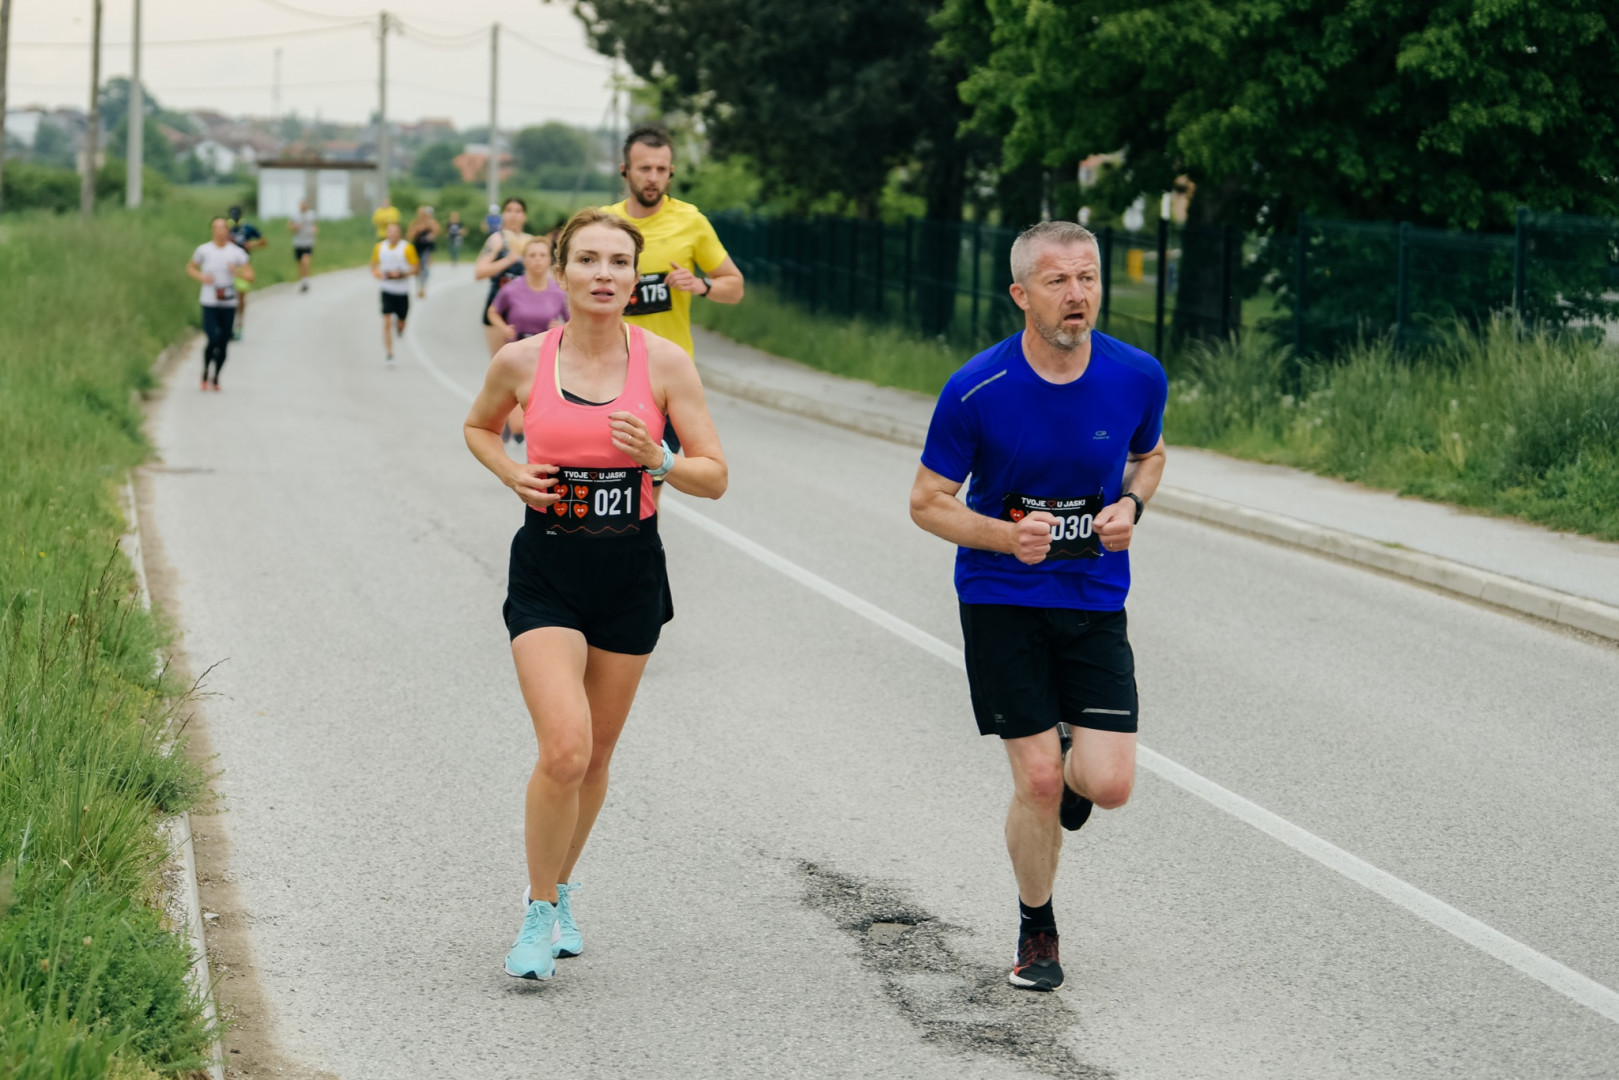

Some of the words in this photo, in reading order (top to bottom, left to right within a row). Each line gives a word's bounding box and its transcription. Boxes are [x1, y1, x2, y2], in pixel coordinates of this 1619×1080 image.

[640, 283, 668, 303] 175
[563, 470, 589, 479] TVOJE
[605, 471, 627, 479] JASKI
[594, 486, 633, 516] 021
[1021, 496, 1047, 507] TVOJE
[1063, 499, 1086, 508] JASKI
[1050, 513, 1094, 541] 030
